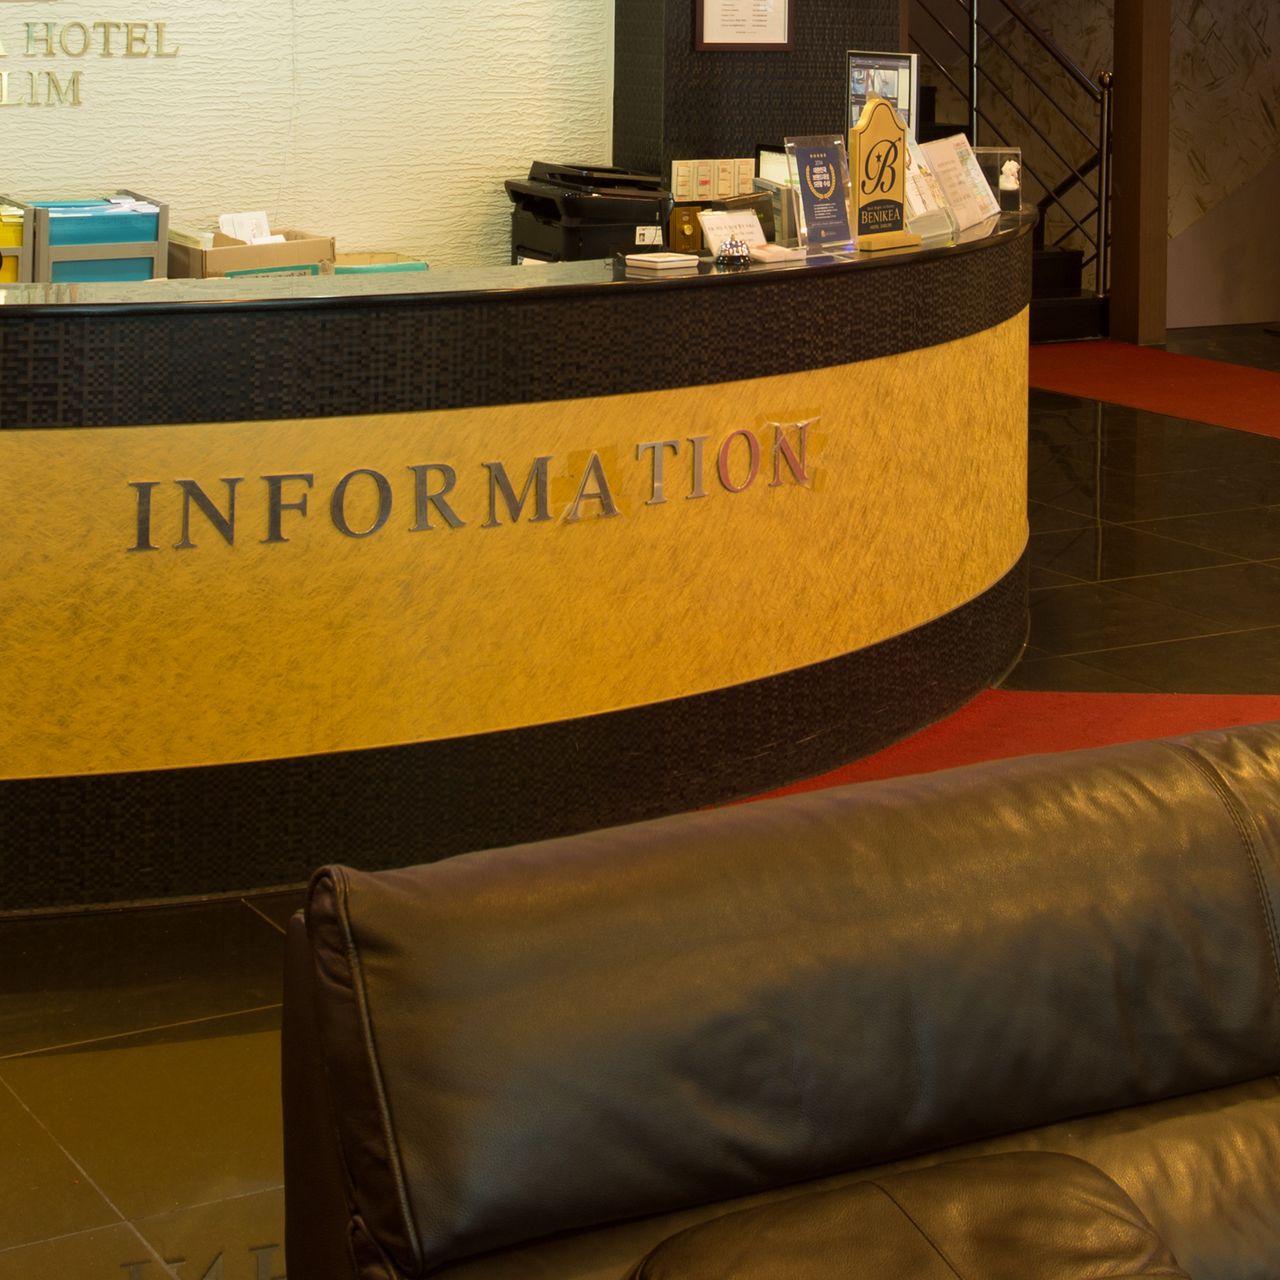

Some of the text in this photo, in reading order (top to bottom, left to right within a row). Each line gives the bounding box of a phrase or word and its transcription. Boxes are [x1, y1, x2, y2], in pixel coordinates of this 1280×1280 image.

[24, 21, 180, 58] HOTEL
[861, 207, 901, 224] BENIKEA
[127, 418, 819, 552] INFORMATION
